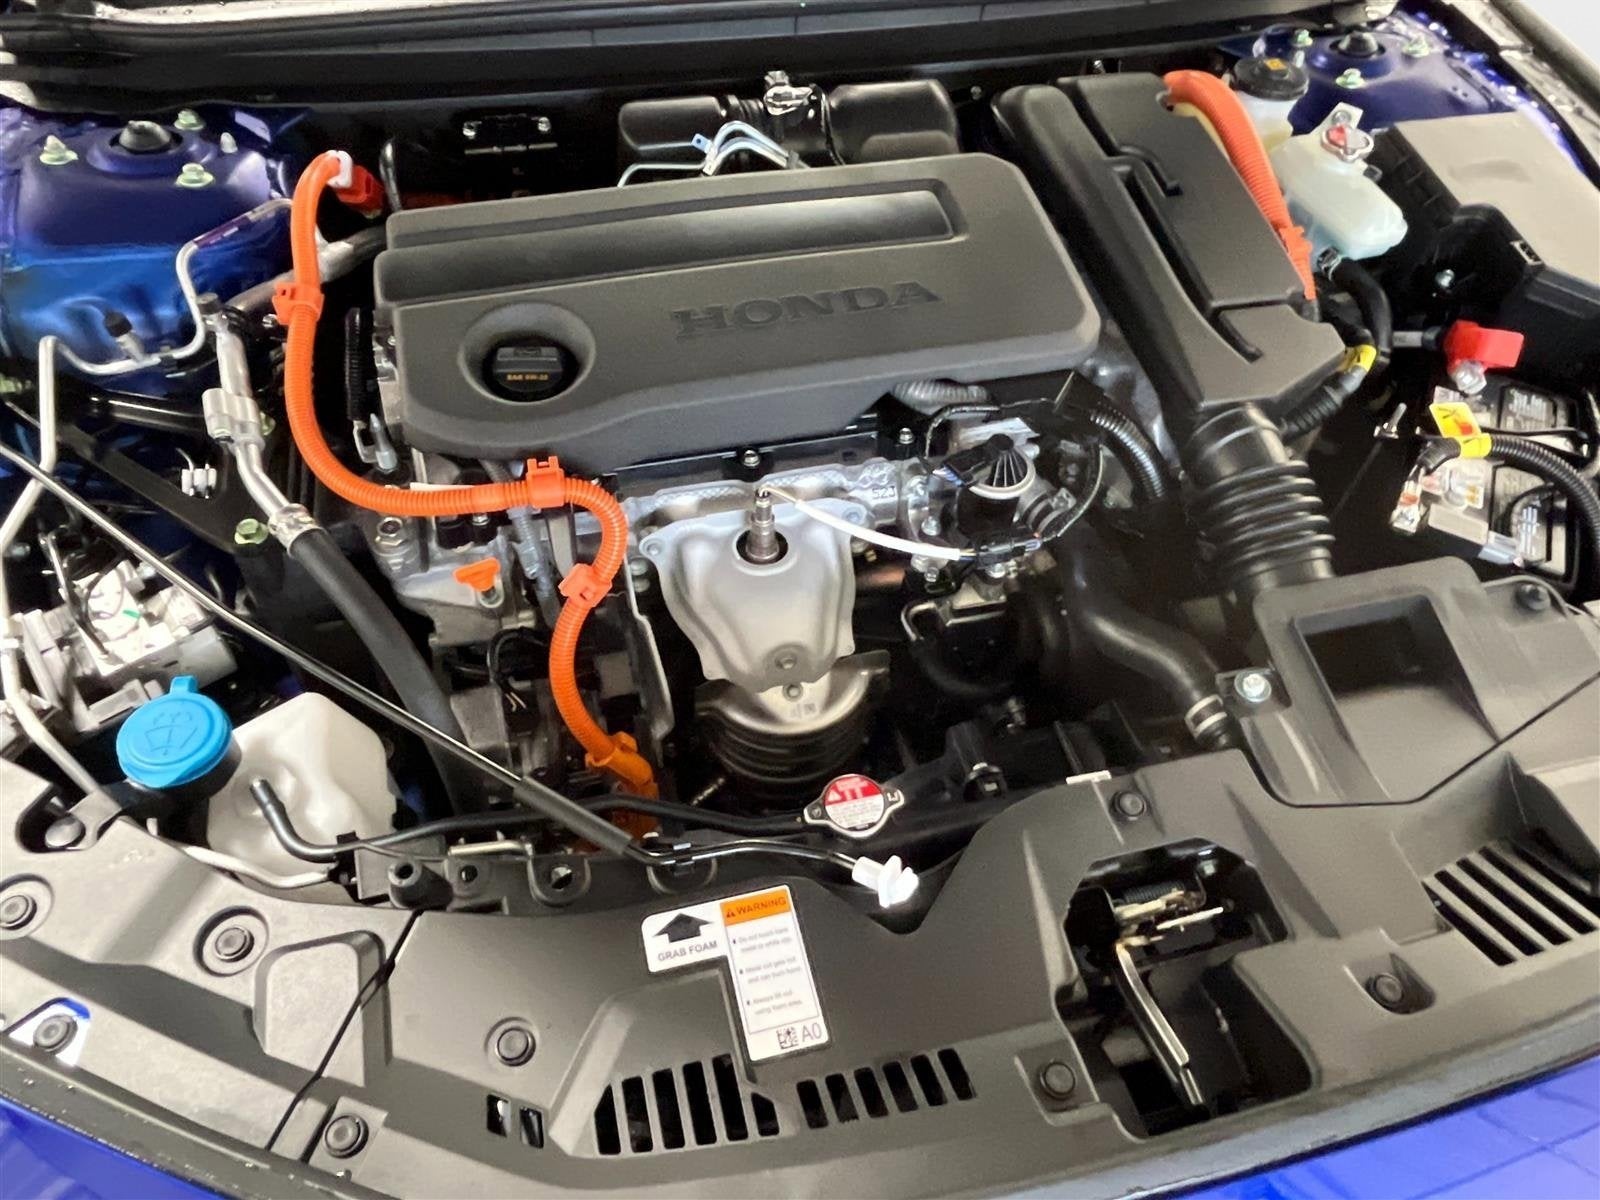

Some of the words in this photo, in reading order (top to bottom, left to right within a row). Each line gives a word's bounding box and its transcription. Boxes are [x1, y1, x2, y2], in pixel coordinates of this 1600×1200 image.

[671, 280, 940, 338] HONDA
[736, 897, 787, 914] WARNING
[657, 948, 687, 961] GRAB
[688, 940, 718, 954] FOAM
[801, 1022, 822, 1042] A0
